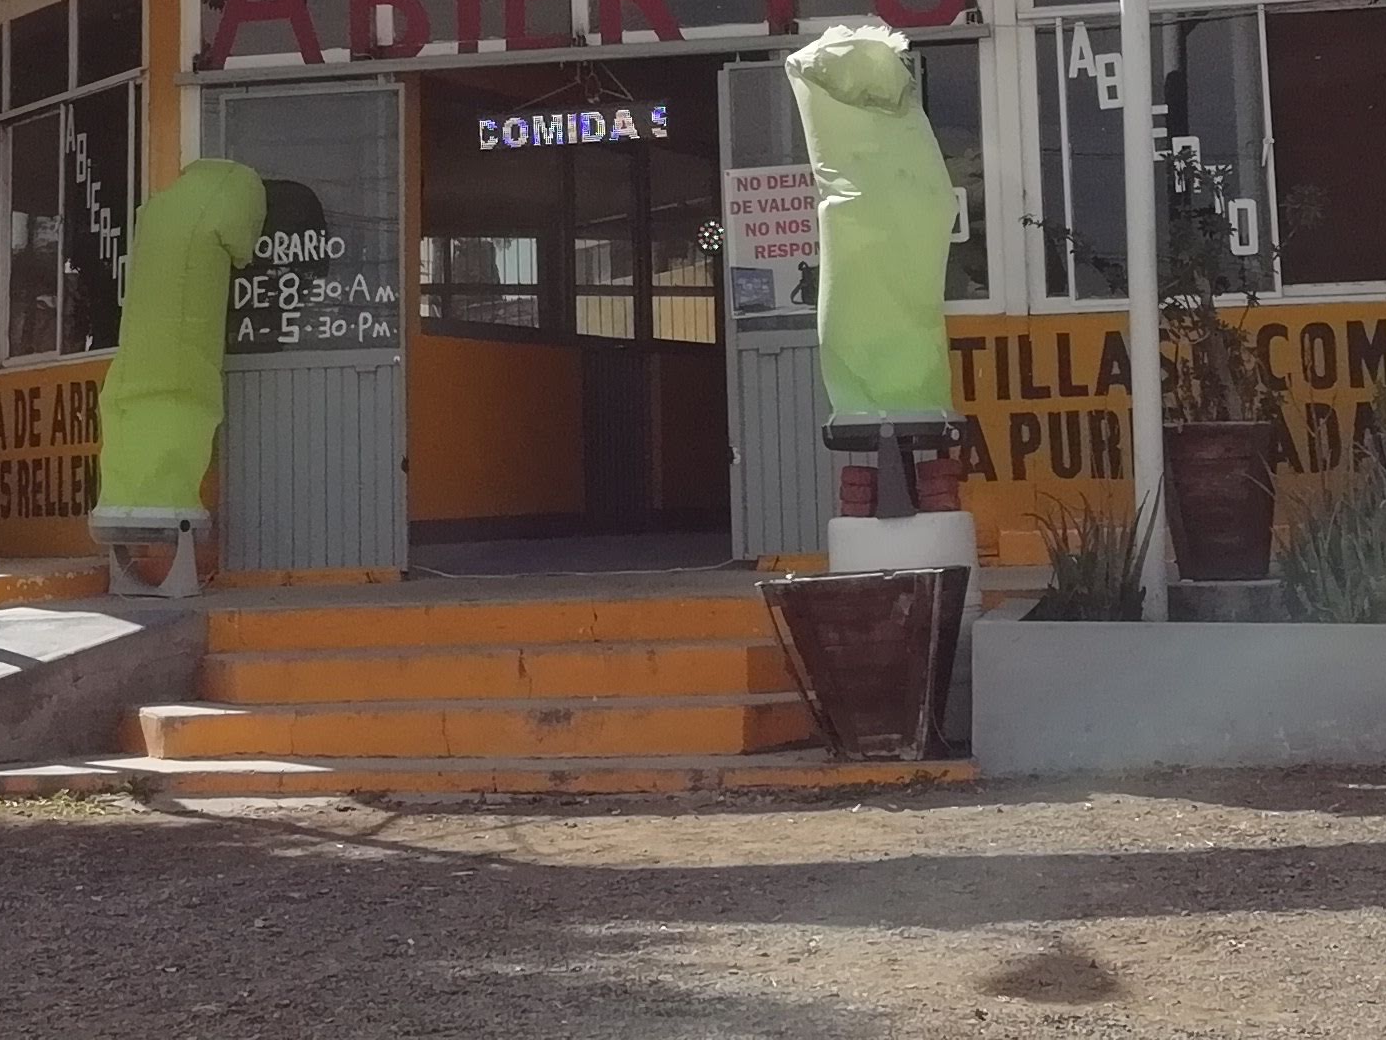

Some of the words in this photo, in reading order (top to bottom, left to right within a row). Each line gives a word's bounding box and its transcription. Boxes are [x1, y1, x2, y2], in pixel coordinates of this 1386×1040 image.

[736, 177, 761, 192] NO
[730, 200, 753, 215] DE
[757, 196, 815, 213] VALOR
[745, 222, 769, 237] NO
[776, 219, 812, 235] NOS
[254, 229, 346, 265] ORARiO
[14, 386, 42, 450] DE
[50, 380, 100, 447] ARR
[18, 454, 99, 518] RELLEN
